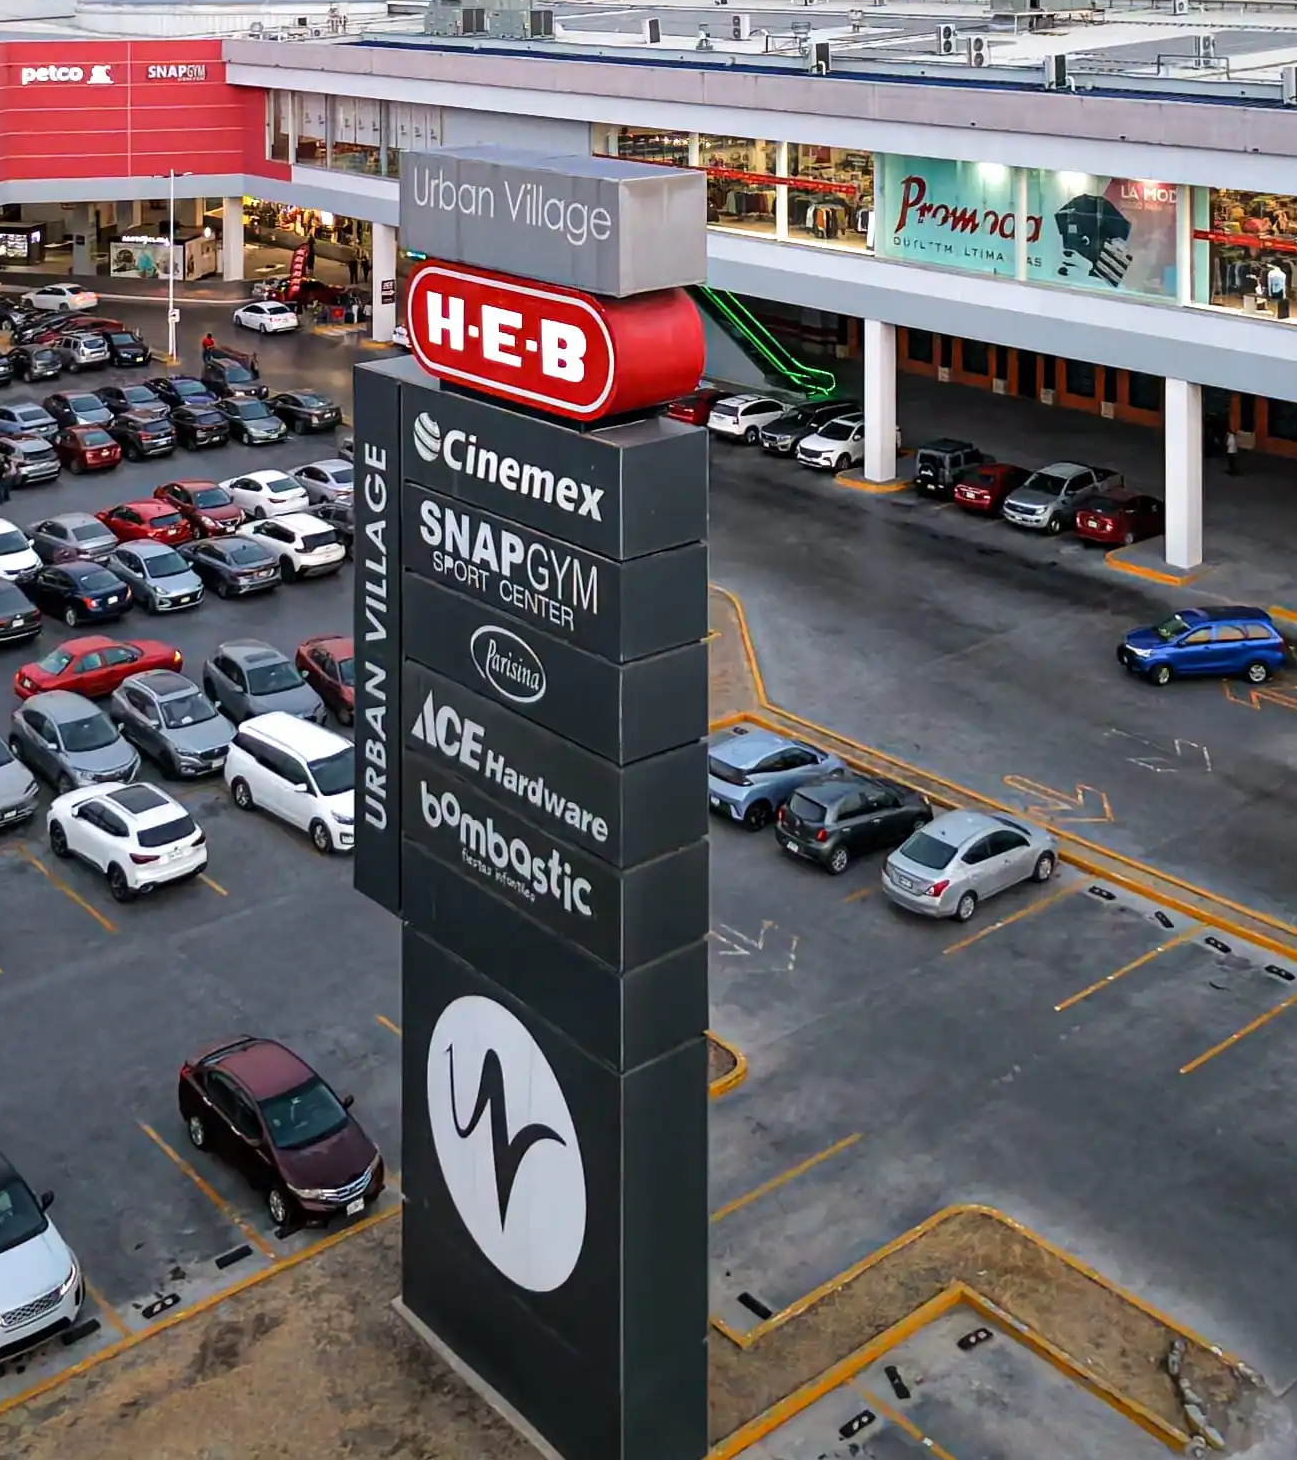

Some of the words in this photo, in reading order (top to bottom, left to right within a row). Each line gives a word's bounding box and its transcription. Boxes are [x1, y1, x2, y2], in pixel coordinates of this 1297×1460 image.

[21, 65, 84, 85] petco
[413, 167, 495, 218] Urban
[504, 180, 613, 246] Village
[943, 242, 1042, 268] MLTIMAAS
[442, 428, 605, 521] Cinemex
[364, 442, 389, 642] VILLAGE
[433, 551, 490, 593] SPORT
[498, 581, 575, 631] CENTER
[485, 638, 541, 691] Parisina
[364, 660, 389, 830] URBAN
[411, 689, 485, 772] ACE
[484, 750, 609, 842] Hardware
[420, 781, 594, 917] bombastic
